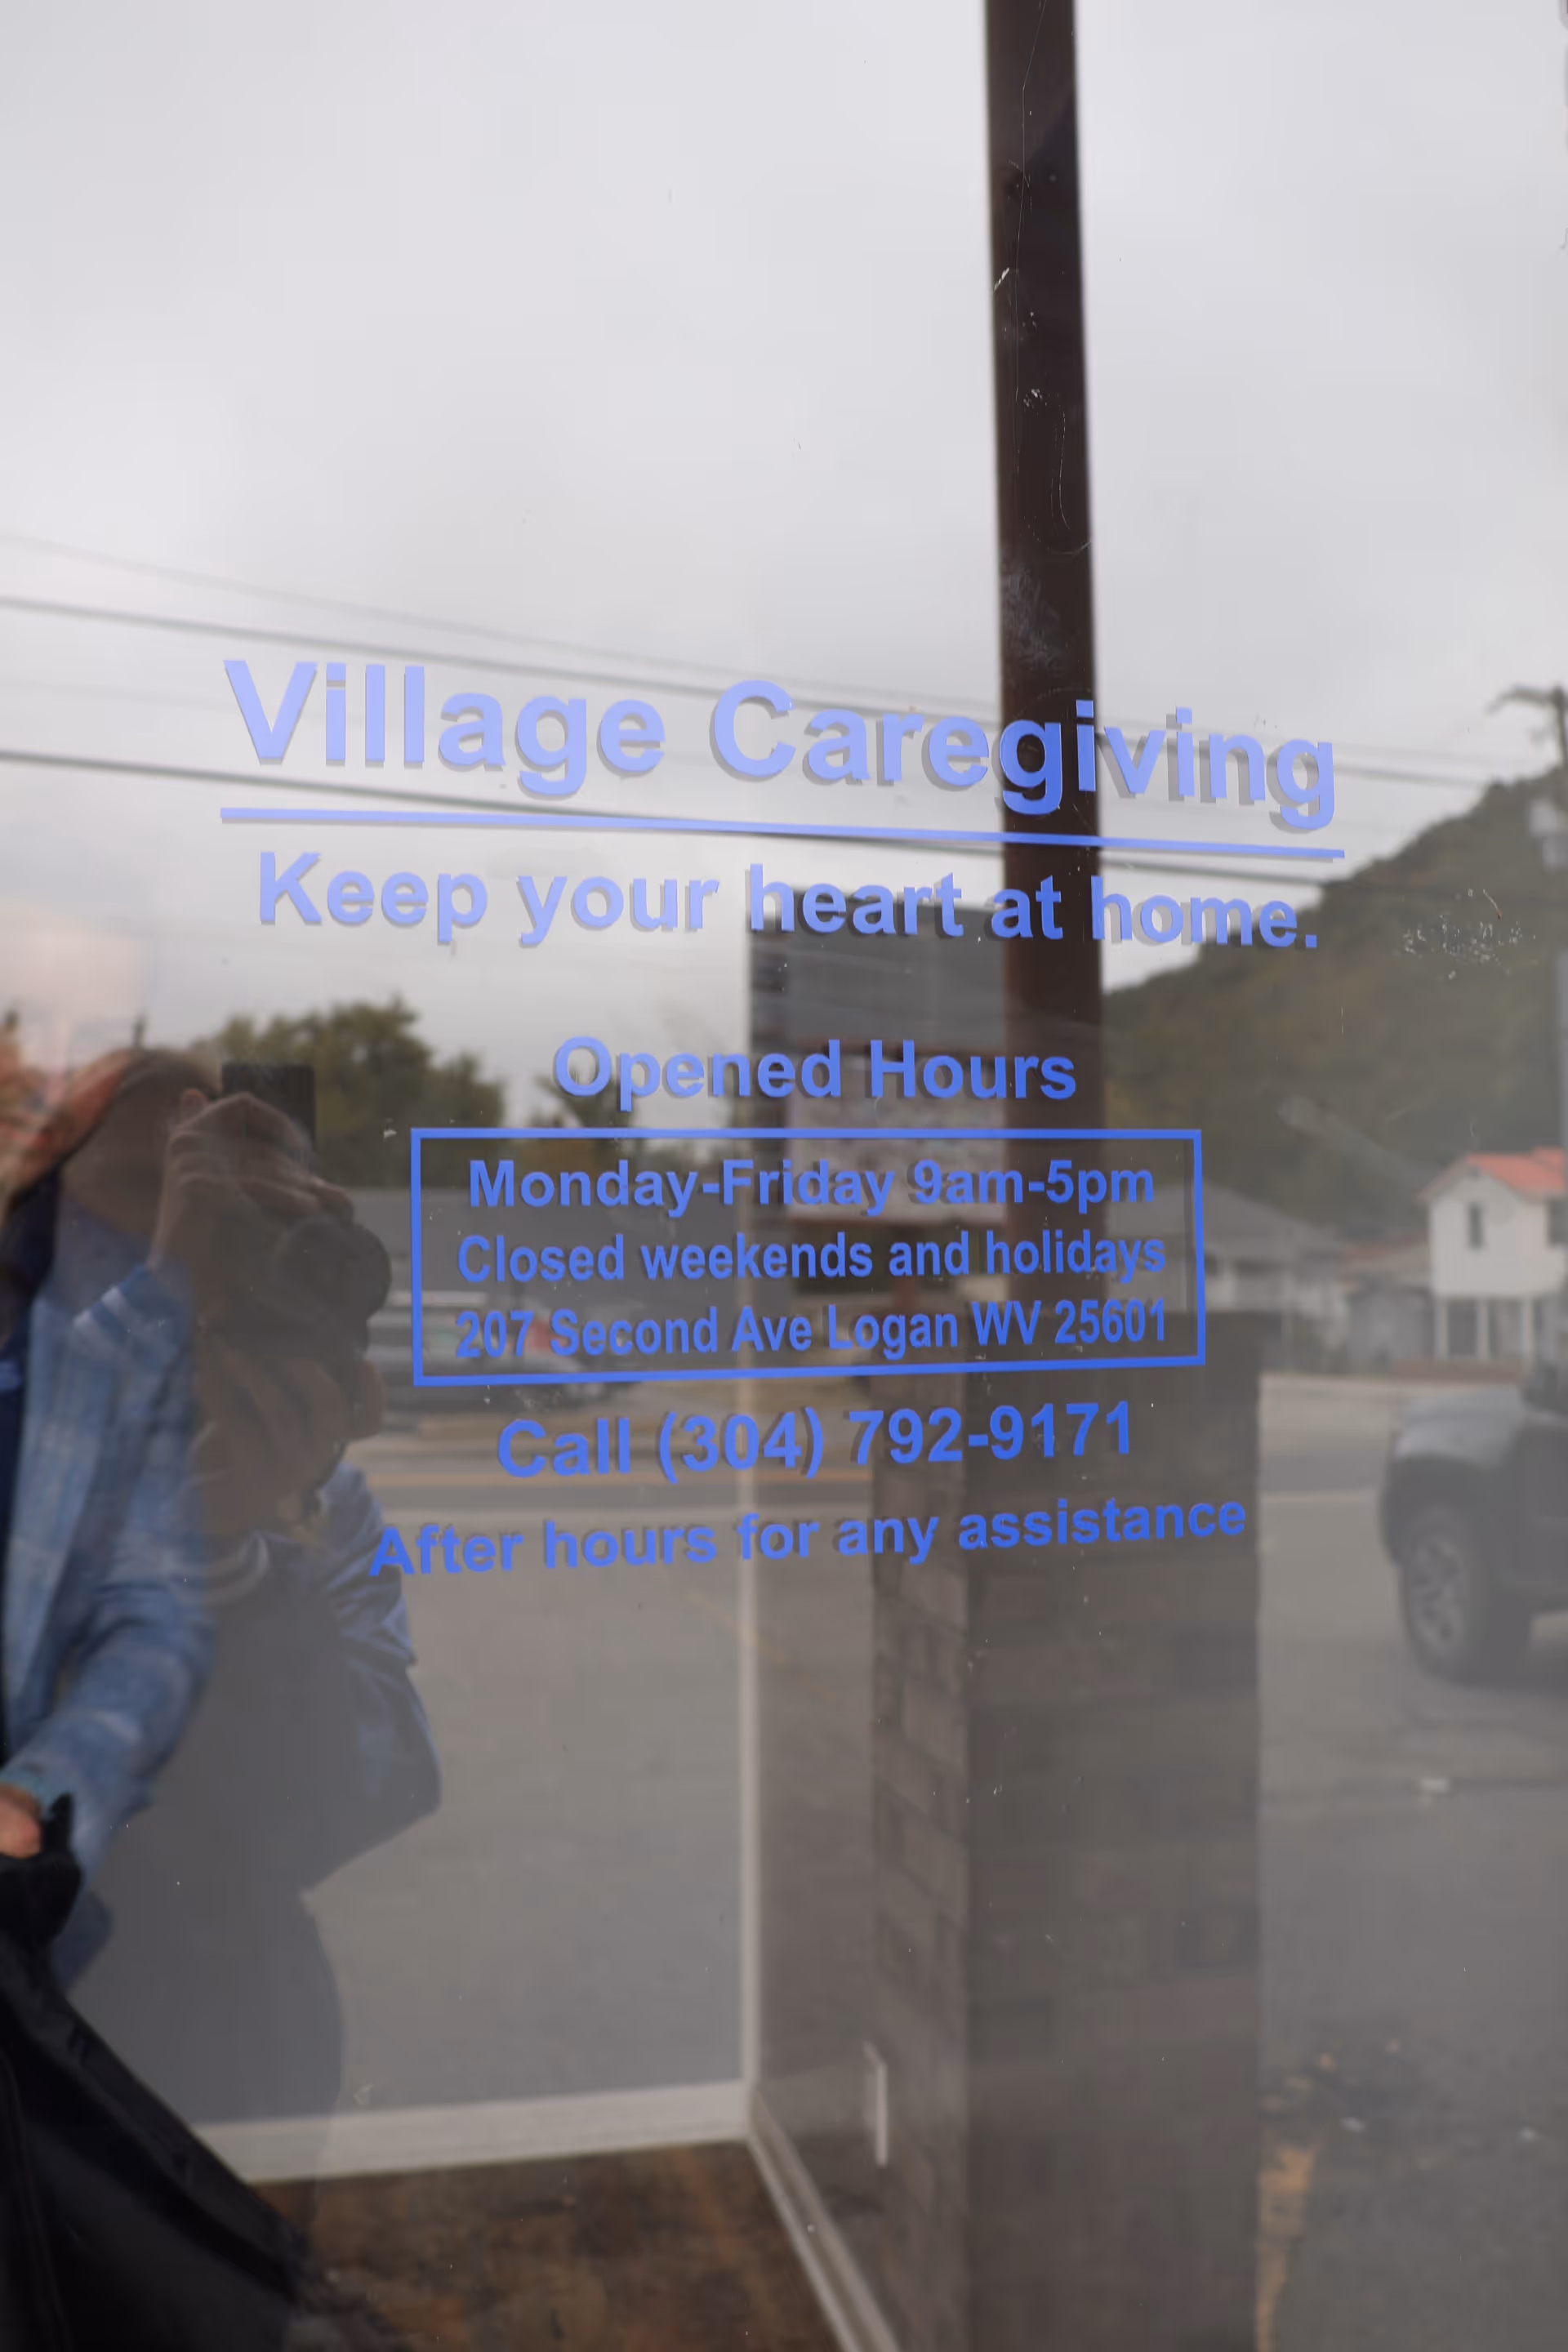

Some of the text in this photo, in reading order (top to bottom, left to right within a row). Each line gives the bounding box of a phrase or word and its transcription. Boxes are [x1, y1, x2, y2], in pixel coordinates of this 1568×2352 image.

[225, 660, 1335, 830] Village Caregiving
[260, 852, 1317, 948] Keep your heart at home.
[555, 1036, 1077, 1112] Opened Hours
[469, 1159, 1155, 1218] Monday-Friday 9am-5pm
[457, 1228, 1166, 1285] Closed weekends and holidays
[456, 1297, 1165, 1361] 207 Second Ave Logan WV 25601
[497, 1400, 1129, 1485] Call (304) 792-9171
[368, 1498, 1246, 1578] After hours for any assistance
